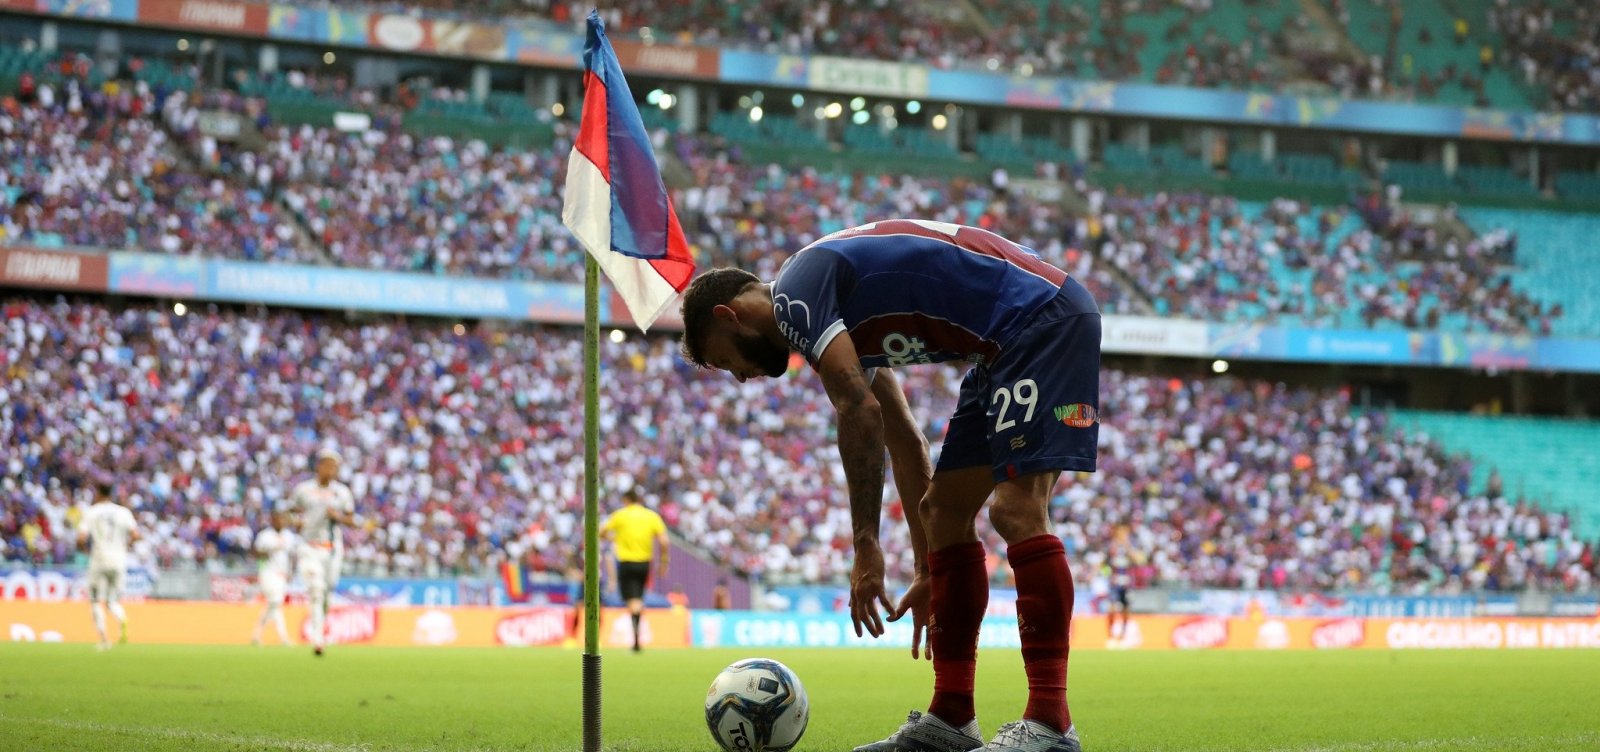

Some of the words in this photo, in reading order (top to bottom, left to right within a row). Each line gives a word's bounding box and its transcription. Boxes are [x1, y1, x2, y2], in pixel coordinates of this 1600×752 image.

[993, 378, 1039, 433] 29
[734, 619, 800, 646] COPA
[729, 721, 754, 752] TO
